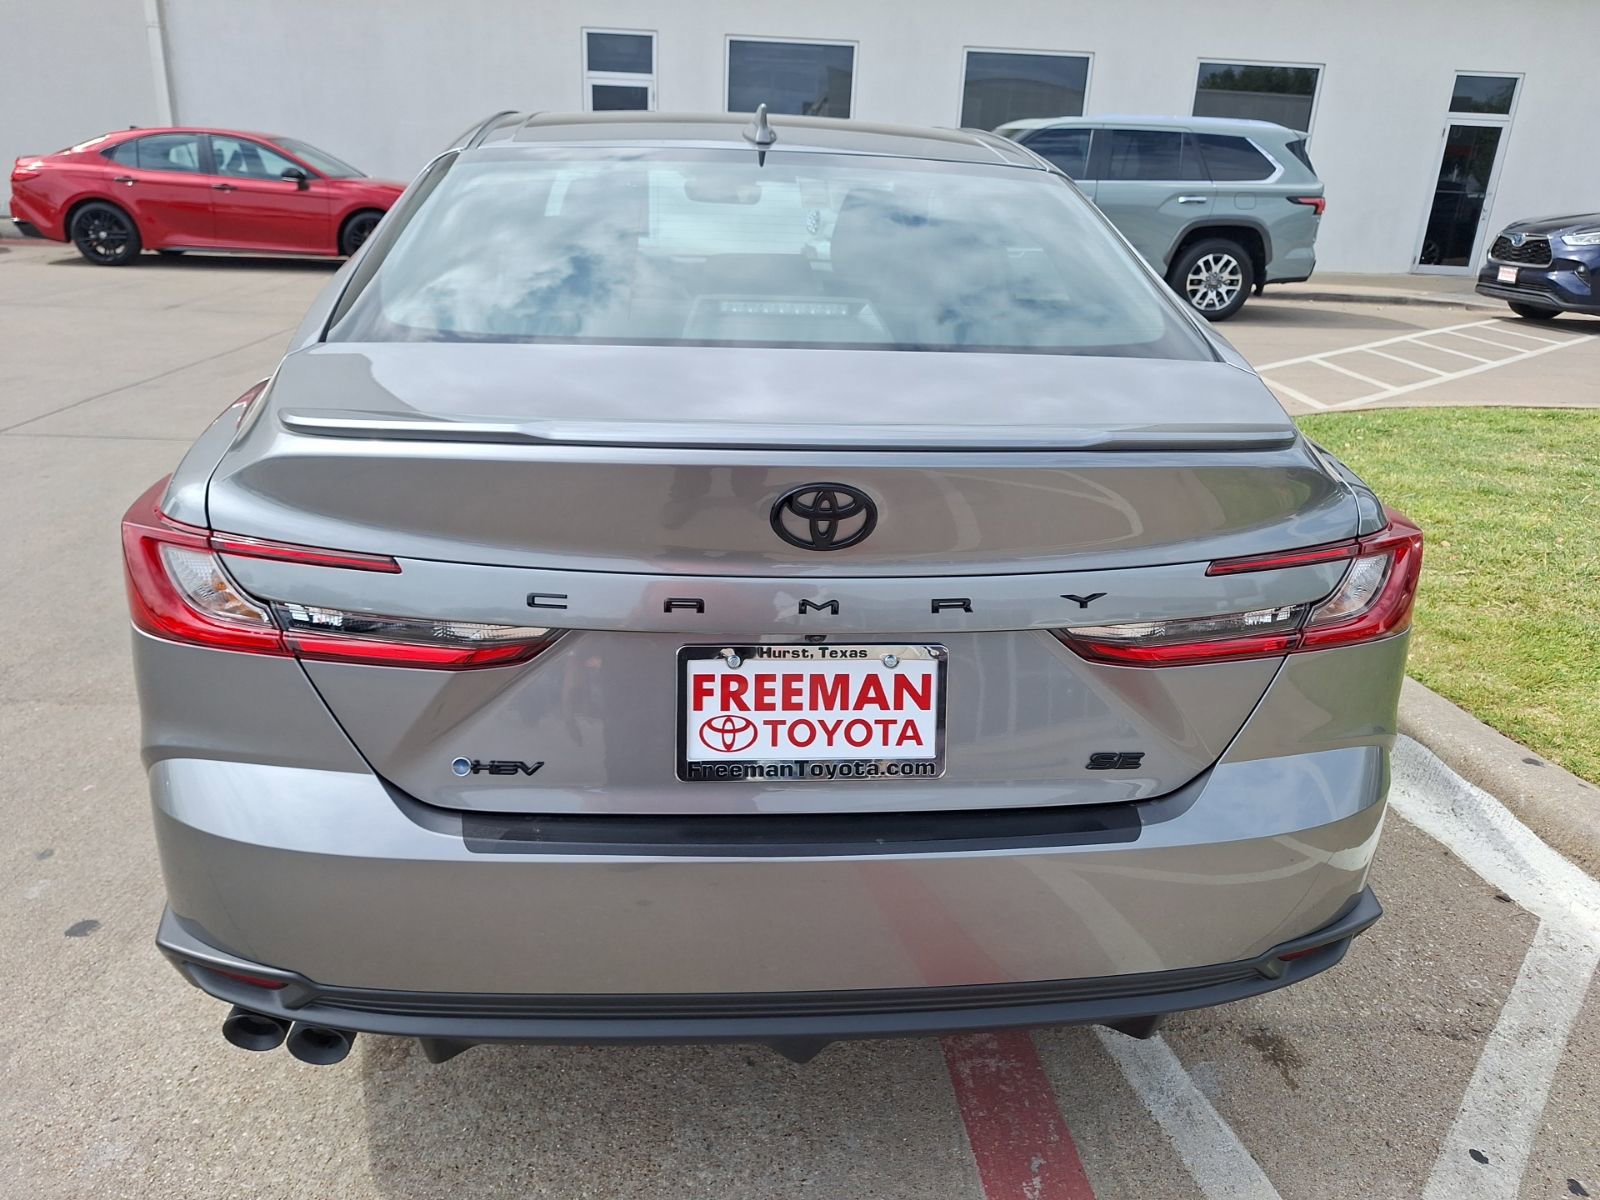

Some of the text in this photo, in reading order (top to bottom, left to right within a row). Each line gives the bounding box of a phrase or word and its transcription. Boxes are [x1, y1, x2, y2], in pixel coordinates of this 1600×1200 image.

[525, 592, 1107, 615] CAMRY
[758, 646, 868, 660] Hurst, Texas
[692, 673, 932, 712] FREEMAN
[763, 719, 924, 747] TOYOTA
[472, 760, 544, 776] HEV
[687, 760, 936, 779] FreemanToyota.com
[1085, 752, 1145, 770] SE
